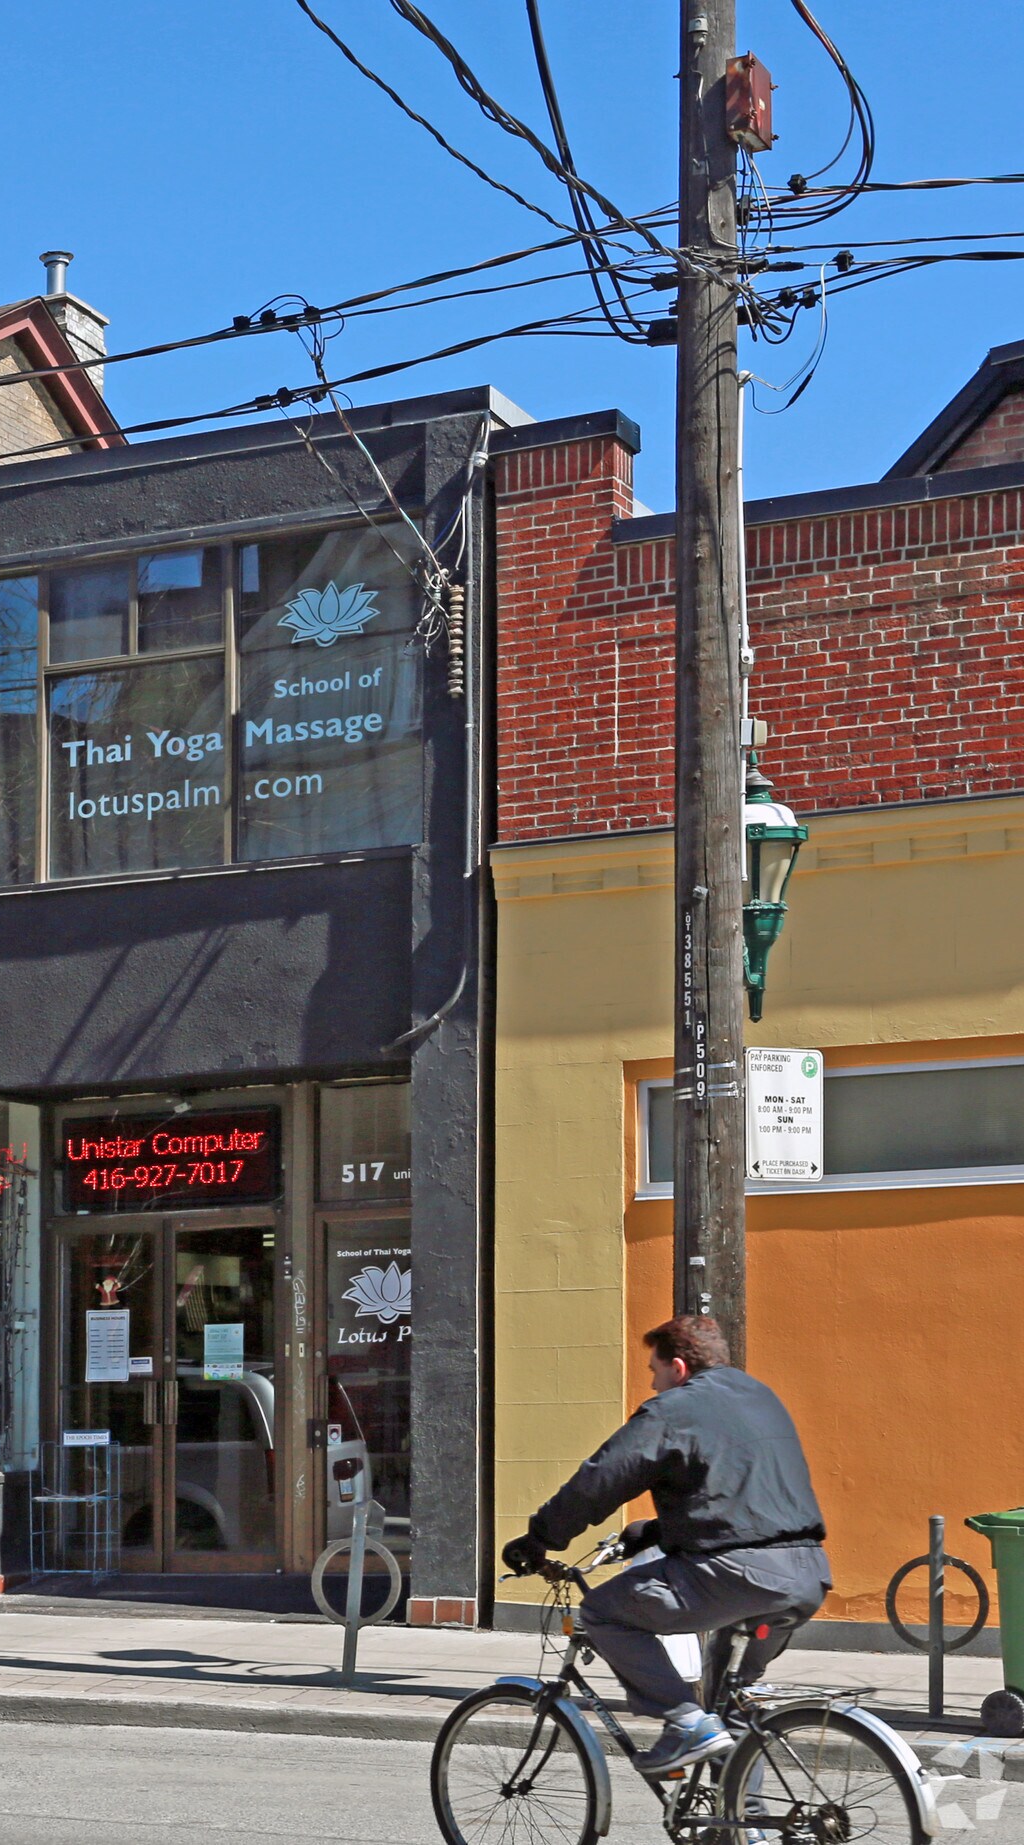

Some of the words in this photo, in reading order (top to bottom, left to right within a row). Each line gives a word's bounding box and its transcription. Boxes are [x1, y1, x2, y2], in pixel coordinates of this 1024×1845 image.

[274, 671, 350, 699] School
[358, 667, 383, 688] of
[62, 735, 131, 768] Thai
[146, 730, 224, 762] Yoga
[245, 712, 383, 747] Massage
[69, 780, 220, 820] lotuspalm
[245, 773, 323, 801] .com
[750, 1053, 762, 1062] PAY
[763, 1054, 791, 1063] PARKING
[750, 1063, 784, 1073] ENFORCED
[764, 1095, 784, 1104] MON
[790, 1096, 806, 1104] SAT
[757, 1105, 771, 1113] 8:00
[788, 1106, 801, 1114] 9:00
[777, 1115, 794, 1124] SUN
[759, 1125, 771, 1133] 1:00
[772, 1125, 782, 1133] PM
[787, 1126, 800, 1134] 9:00
[801, 1126, 812, 1134] PM
[67, 1136, 145, 1161] Unistar
[152, 1128, 264, 1157] Computer
[779, 1160, 808, 1168] PURCHASED
[83, 1160, 245, 1191] 416-927-7017
[342, 1162, 385, 1183] 517
[766, 1167, 783, 1175] TICKET
[784, 1167, 791, 1175] ON
[337, 1249, 362, 1257] School
[364, 1248, 372, 1256] of
[373, 1248, 391, 1256] Thai
[392, 1247, 411, 1257] Yoga
[337, 1327, 387, 1344] Lotus
